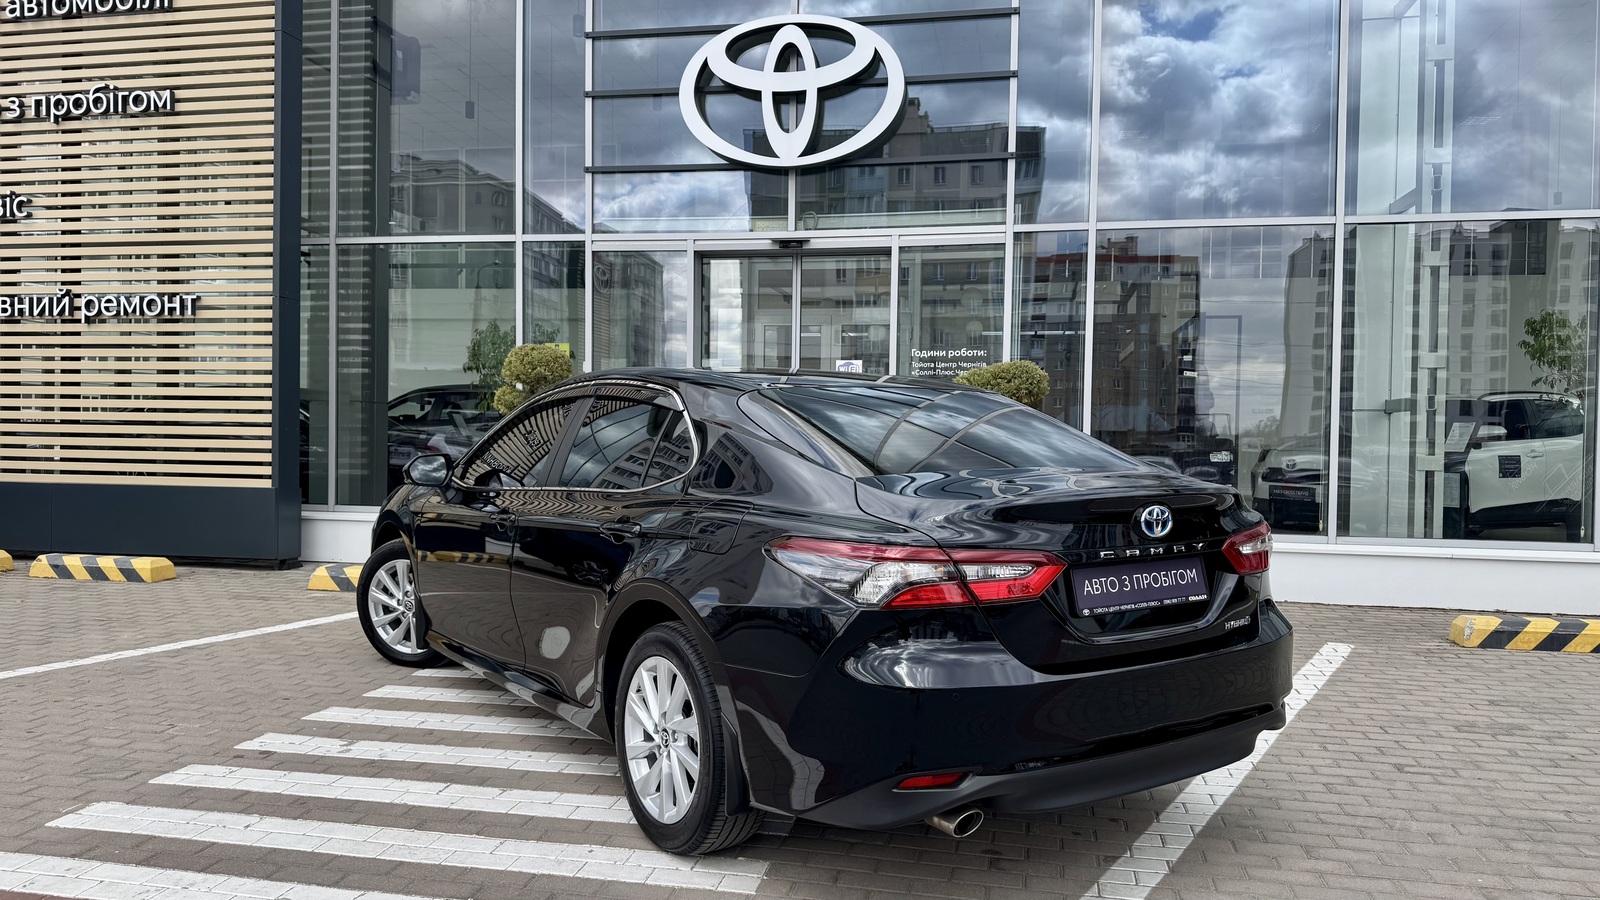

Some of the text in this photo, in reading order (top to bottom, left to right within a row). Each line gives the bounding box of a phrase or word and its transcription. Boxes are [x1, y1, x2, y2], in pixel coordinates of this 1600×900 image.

[6, 83, 173, 124] з пробігом
[81, 293, 199, 324] ремонт
[911, 347, 987, 358] Години роботи:
[935, 361, 957, 369] Центр
[958, 361, 987, 369] Чернігів
[1100, 543, 1205, 558] CAMRY
[1084, 576, 1119, 595] АВТО
[1133, 568, 1198, 590] ПРОБІГОМ
